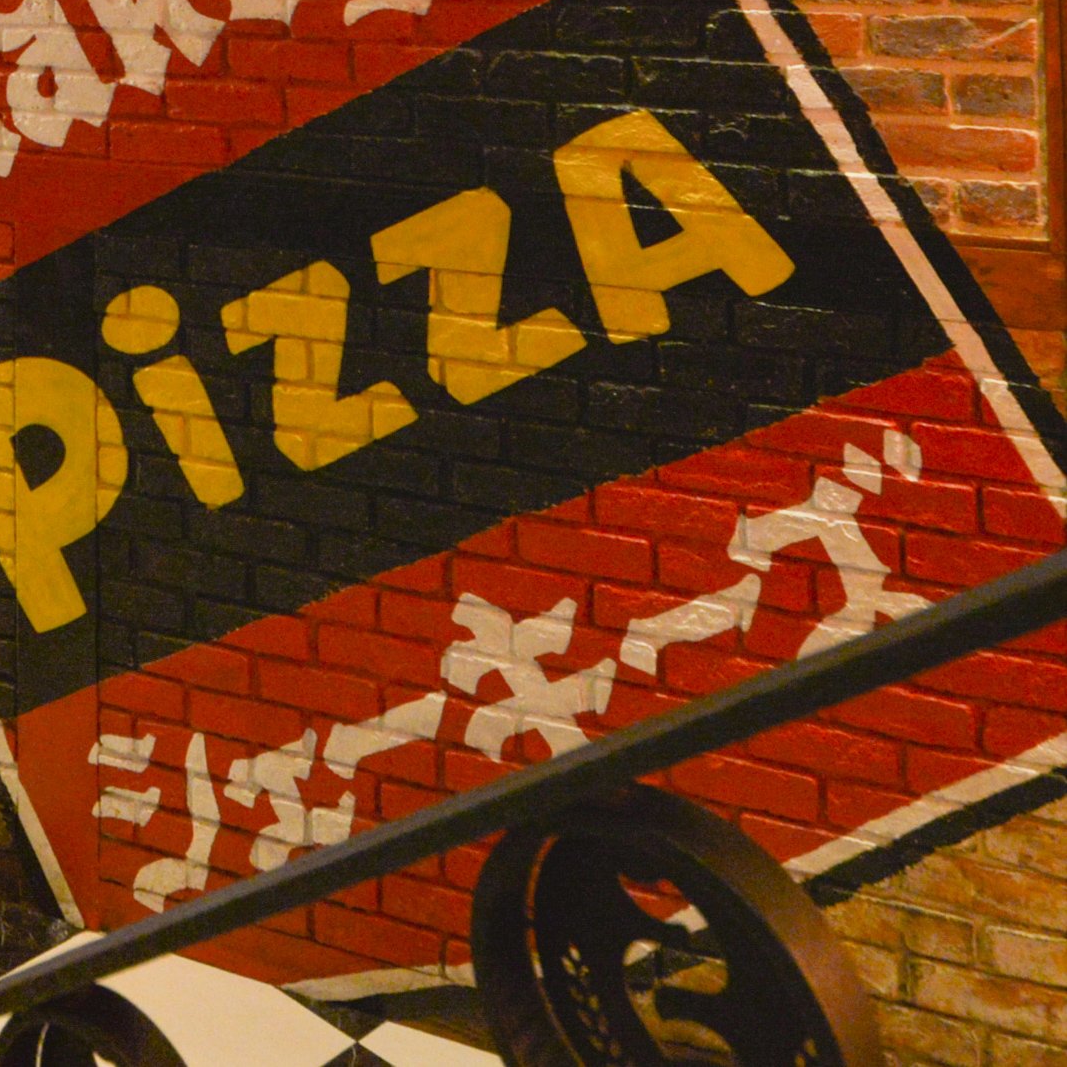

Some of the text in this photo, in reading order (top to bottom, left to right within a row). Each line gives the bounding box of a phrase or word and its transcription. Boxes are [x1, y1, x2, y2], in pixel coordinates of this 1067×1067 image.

[88, 428, 937, 916] シェーキーズ
